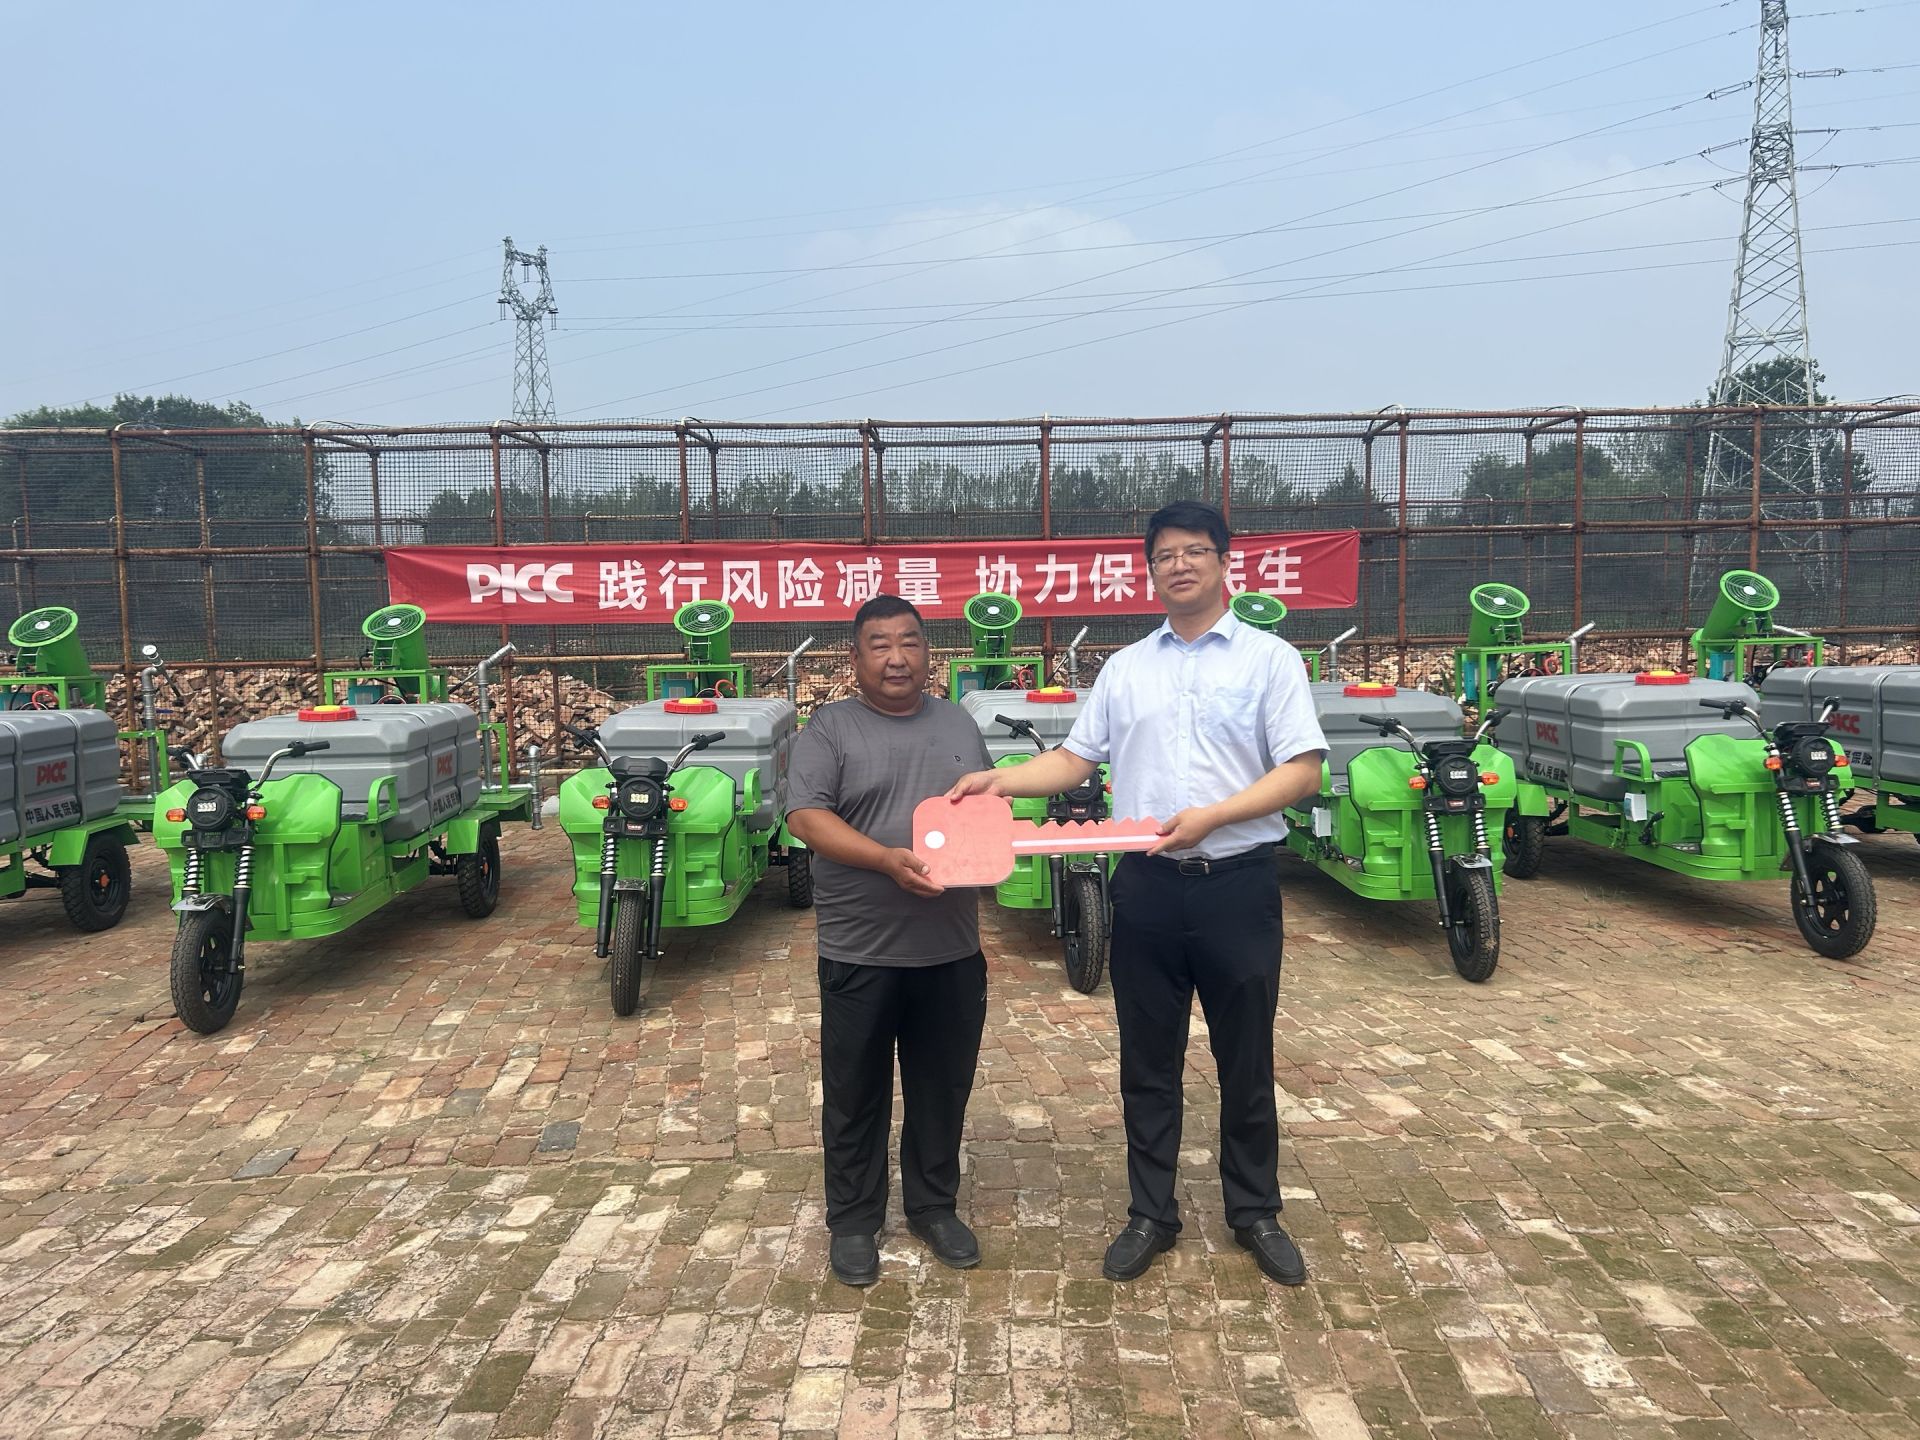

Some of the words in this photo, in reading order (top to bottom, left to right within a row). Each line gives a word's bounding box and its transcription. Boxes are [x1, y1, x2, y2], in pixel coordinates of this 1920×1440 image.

[466, 562, 574, 604] PICC
[598, 557, 943, 610] 践行风险减量
[975, 547, 1303, 605] 协力保民生
[1536, 720, 1560, 745] PICC
[36, 761, 67, 785] PICC
